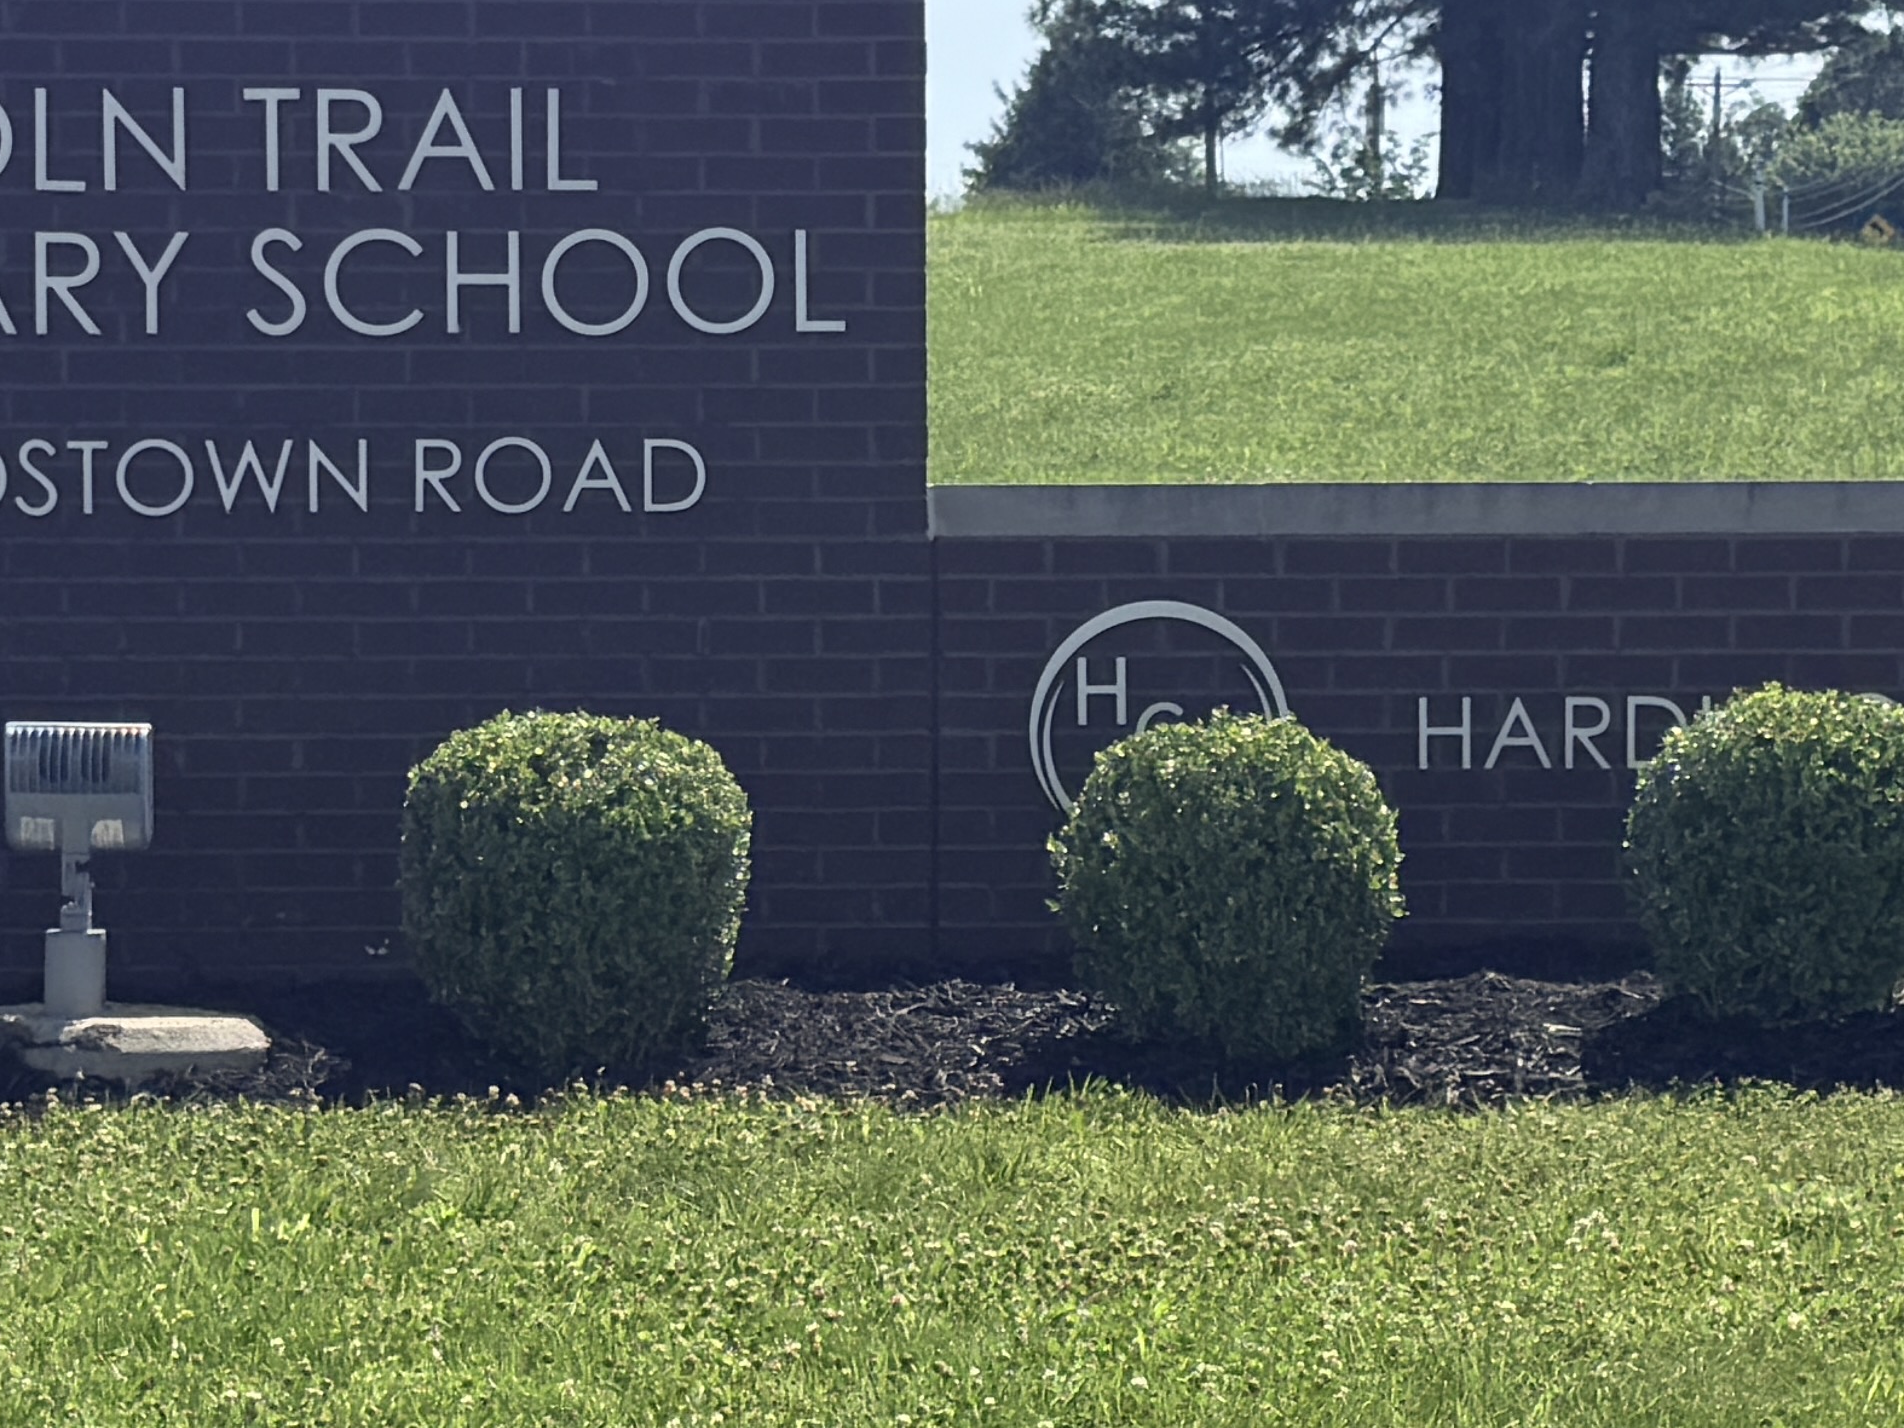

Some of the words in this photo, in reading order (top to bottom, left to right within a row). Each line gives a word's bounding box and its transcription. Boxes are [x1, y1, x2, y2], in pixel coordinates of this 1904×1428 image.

[241, 85, 600, 194] TRAIL
[244, 226, 848, 337] SCHOOL
[413, 435, 708, 514] ROAD
[1417, 694, 1716, 771] HARD
